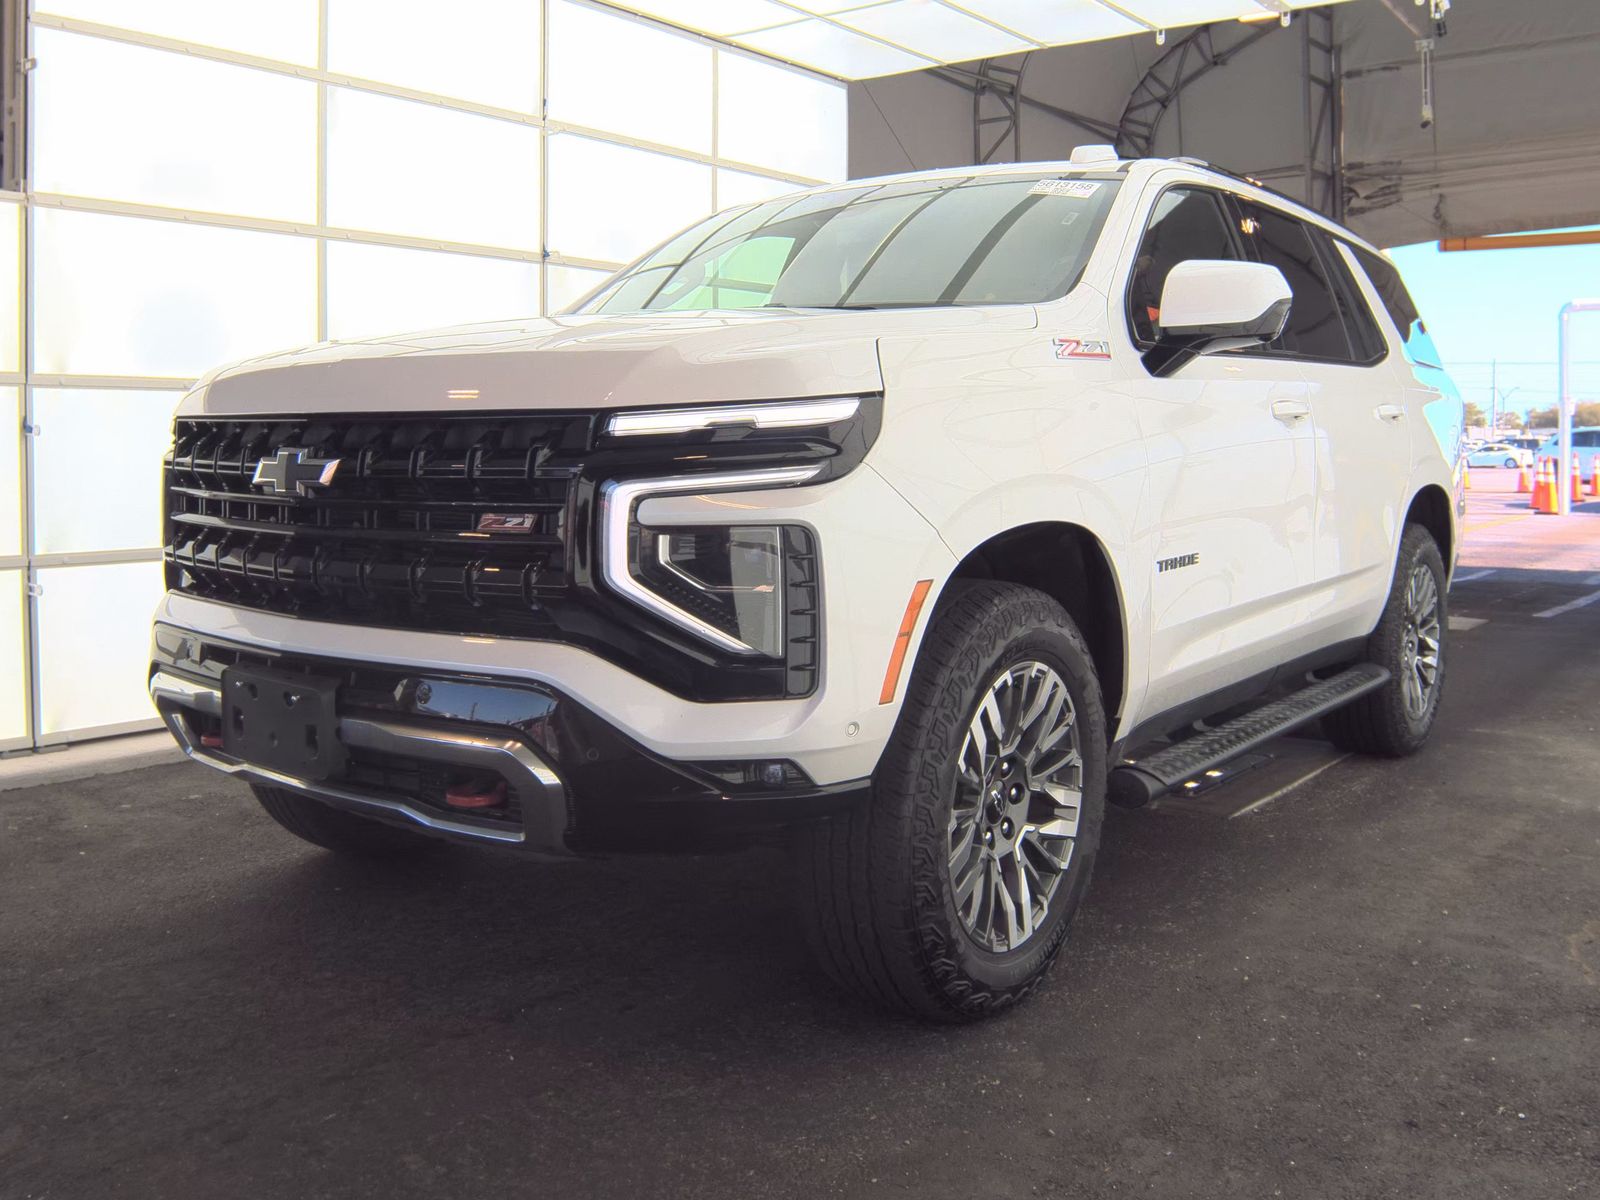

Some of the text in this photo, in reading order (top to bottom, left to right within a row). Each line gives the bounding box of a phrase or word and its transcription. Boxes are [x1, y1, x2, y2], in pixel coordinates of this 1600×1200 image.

[1053, 338, 1112, 360] Z71
[479, 514, 535, 531] Z71
[1156, 552, 1200, 573] TAHOE
